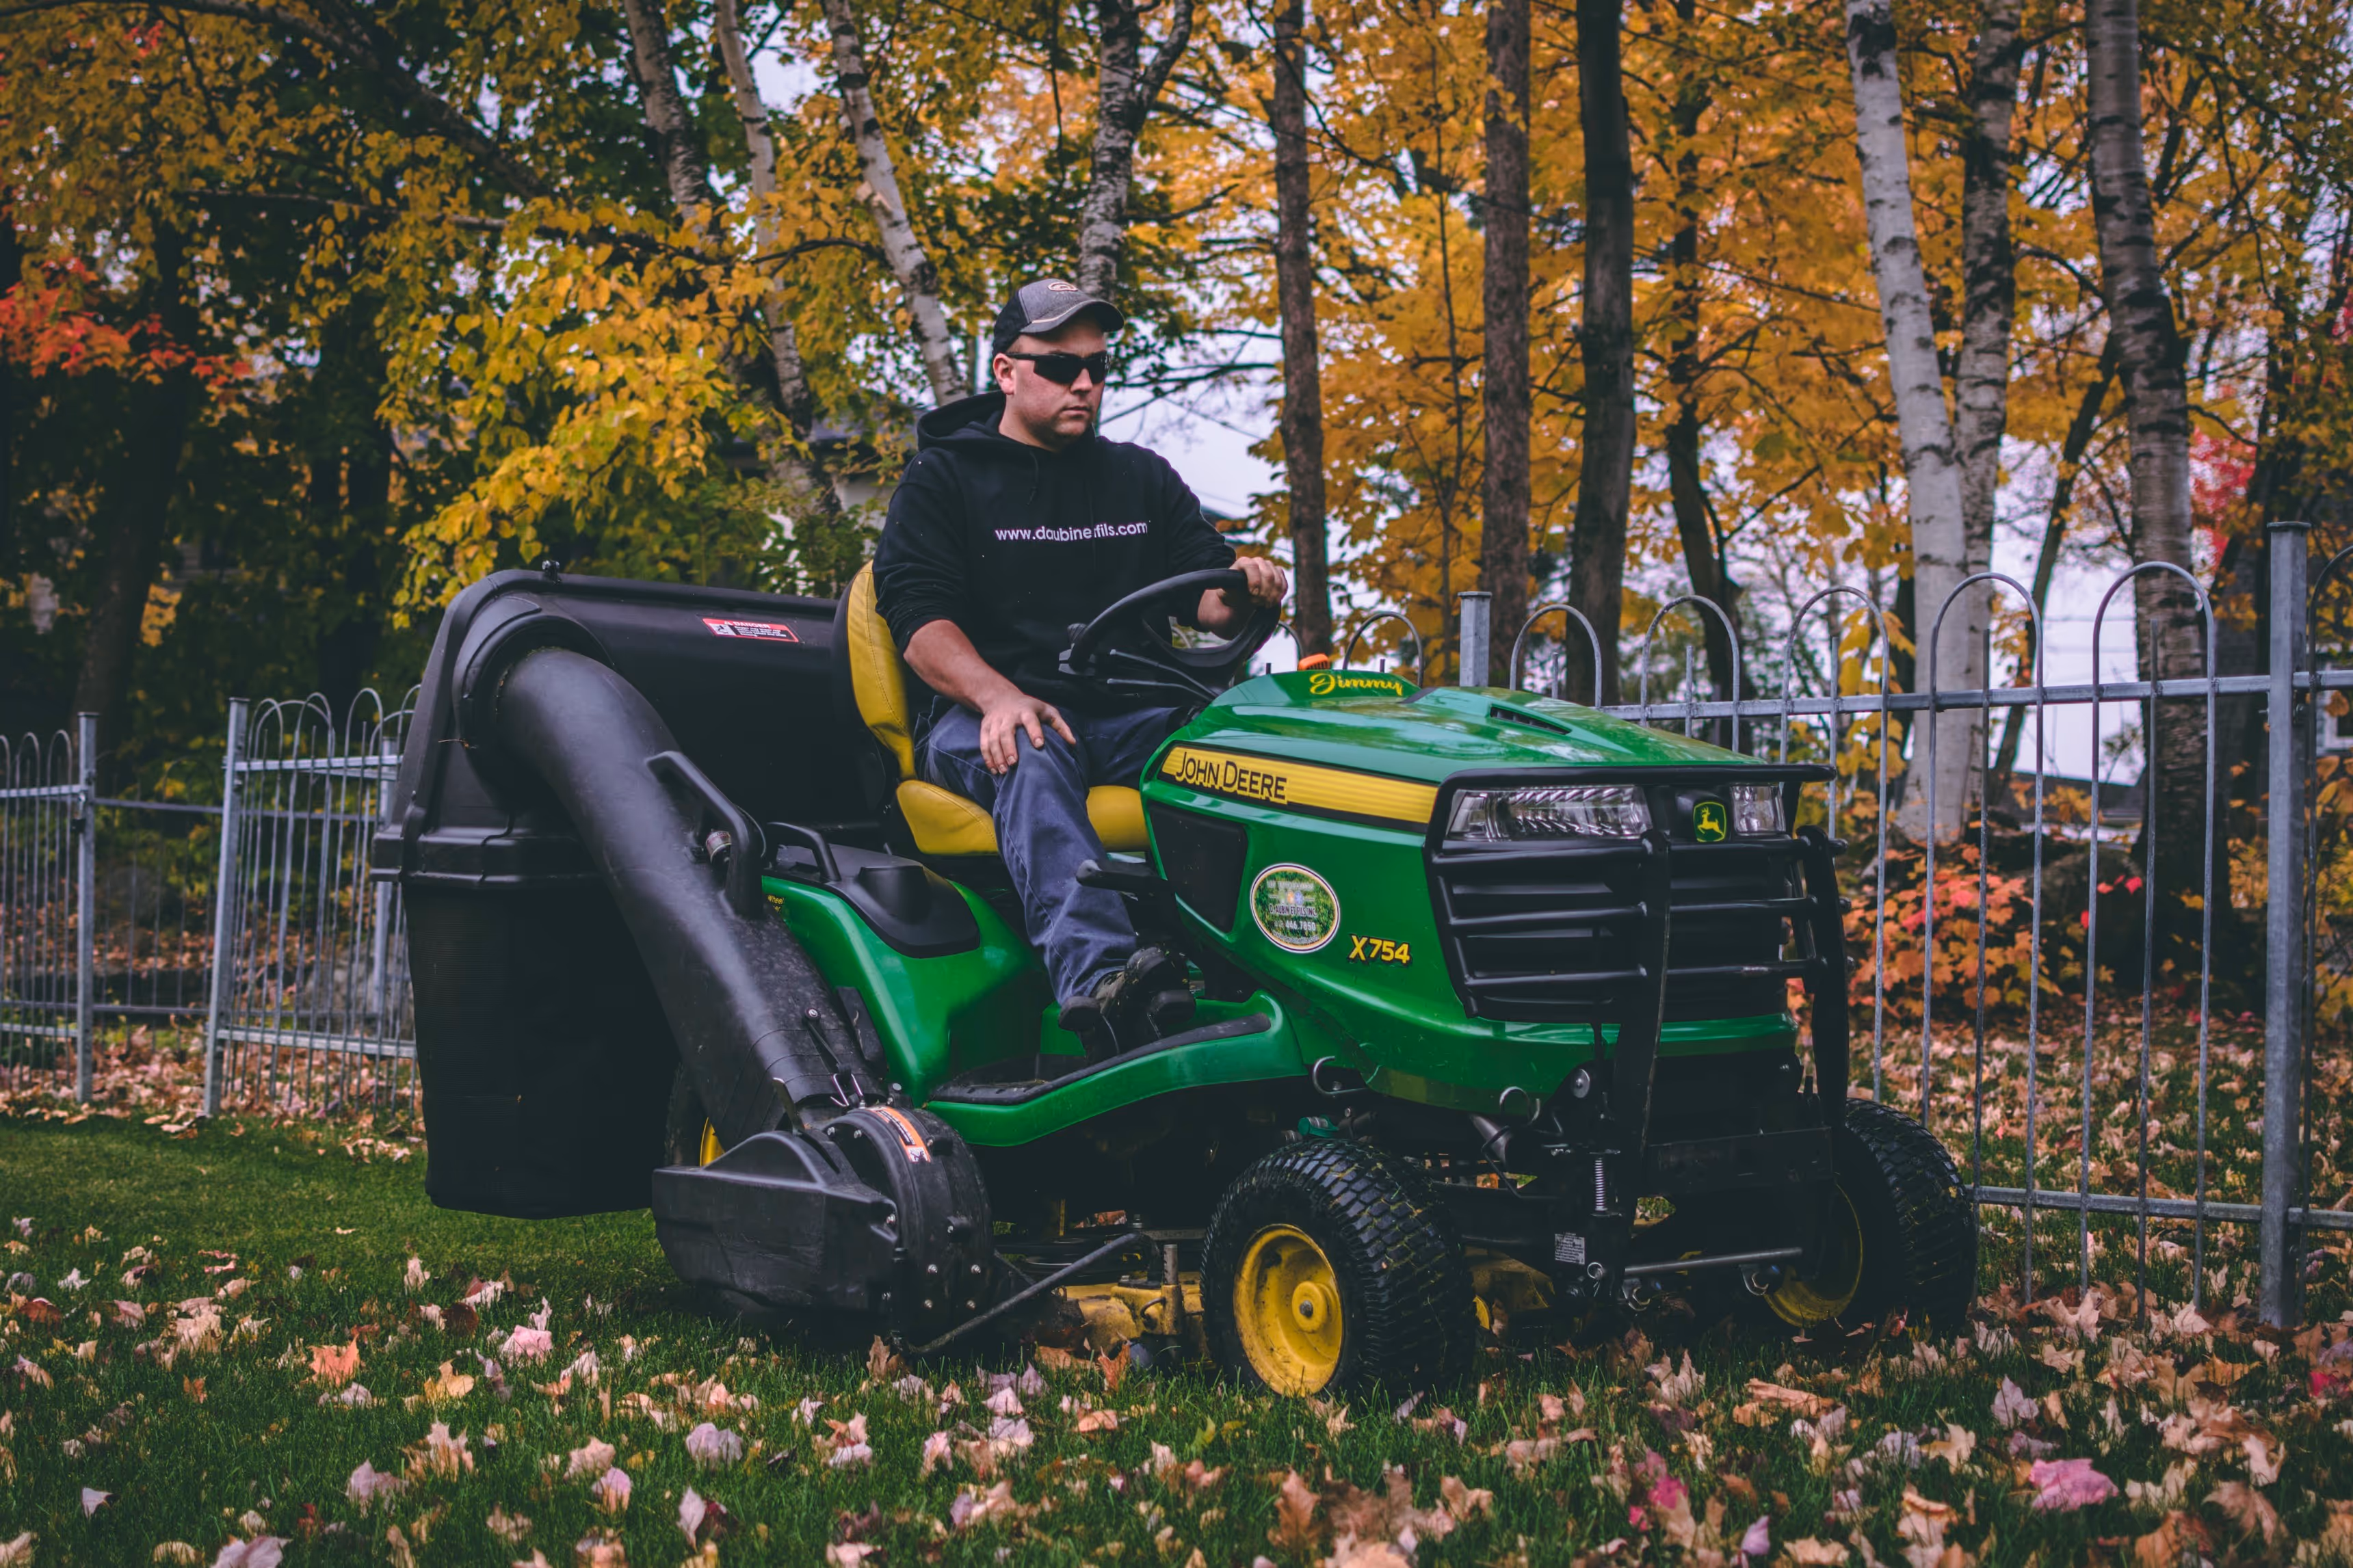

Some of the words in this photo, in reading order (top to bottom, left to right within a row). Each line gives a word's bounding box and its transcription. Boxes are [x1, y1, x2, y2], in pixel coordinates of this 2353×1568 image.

[1309, 673, 1404, 695] Jimmy
[1290, 905, 1296, 915] ET
[1349, 934, 1410, 964] X754
